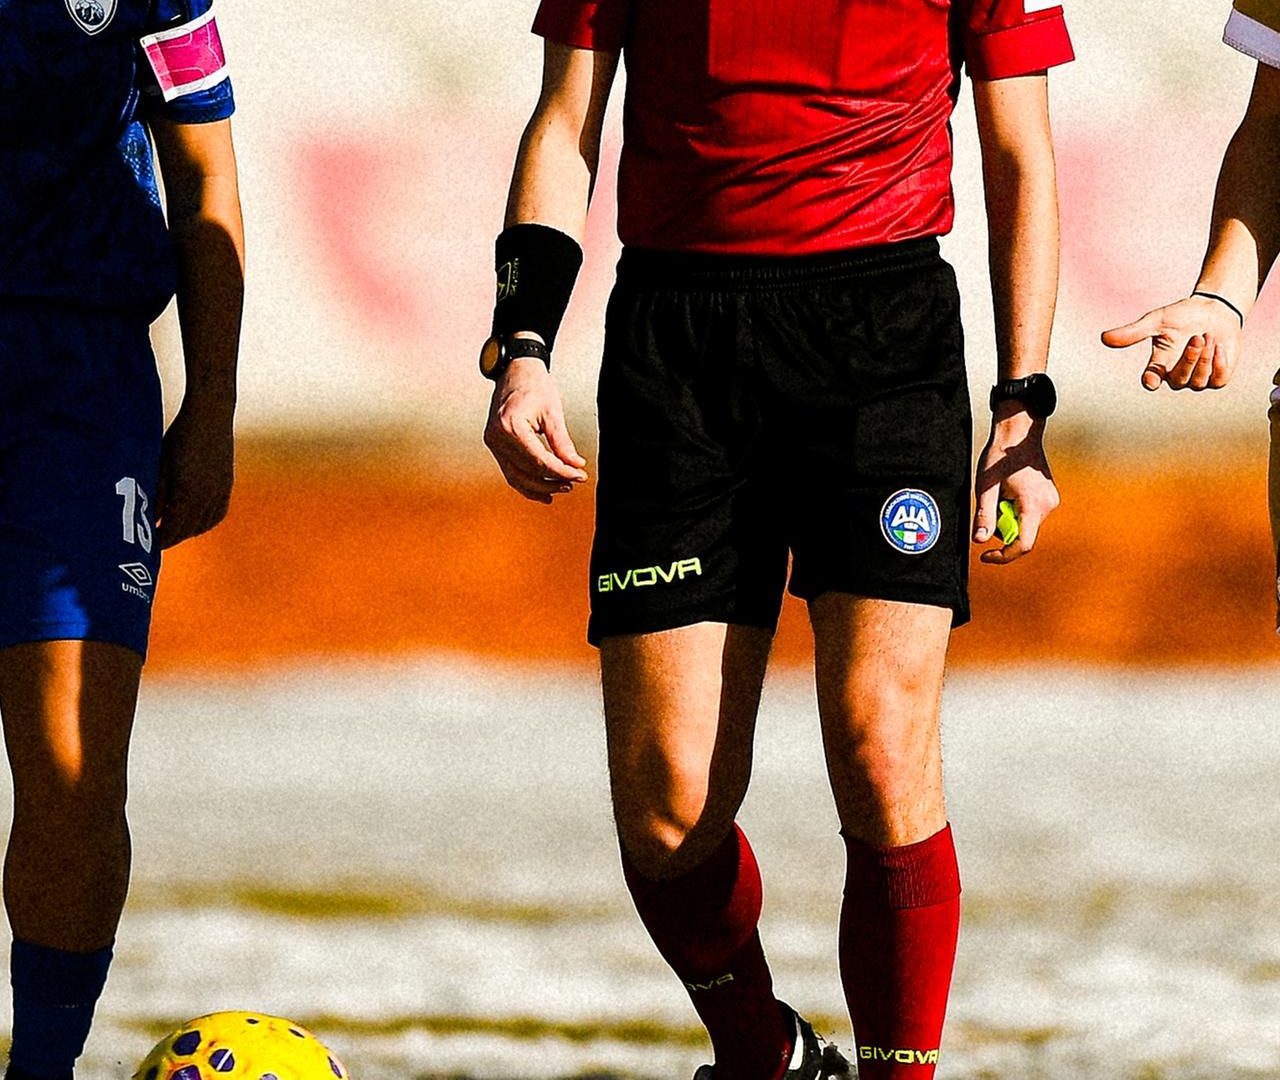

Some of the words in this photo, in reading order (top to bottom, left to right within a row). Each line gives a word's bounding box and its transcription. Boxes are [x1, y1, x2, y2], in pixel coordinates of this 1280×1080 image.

[115, 476, 152, 554] 13
[890, 504, 931, 532] AIA
[598, 557, 702, 592] GIVOVA
[859, 1046, 940, 1065] GIVOVA
